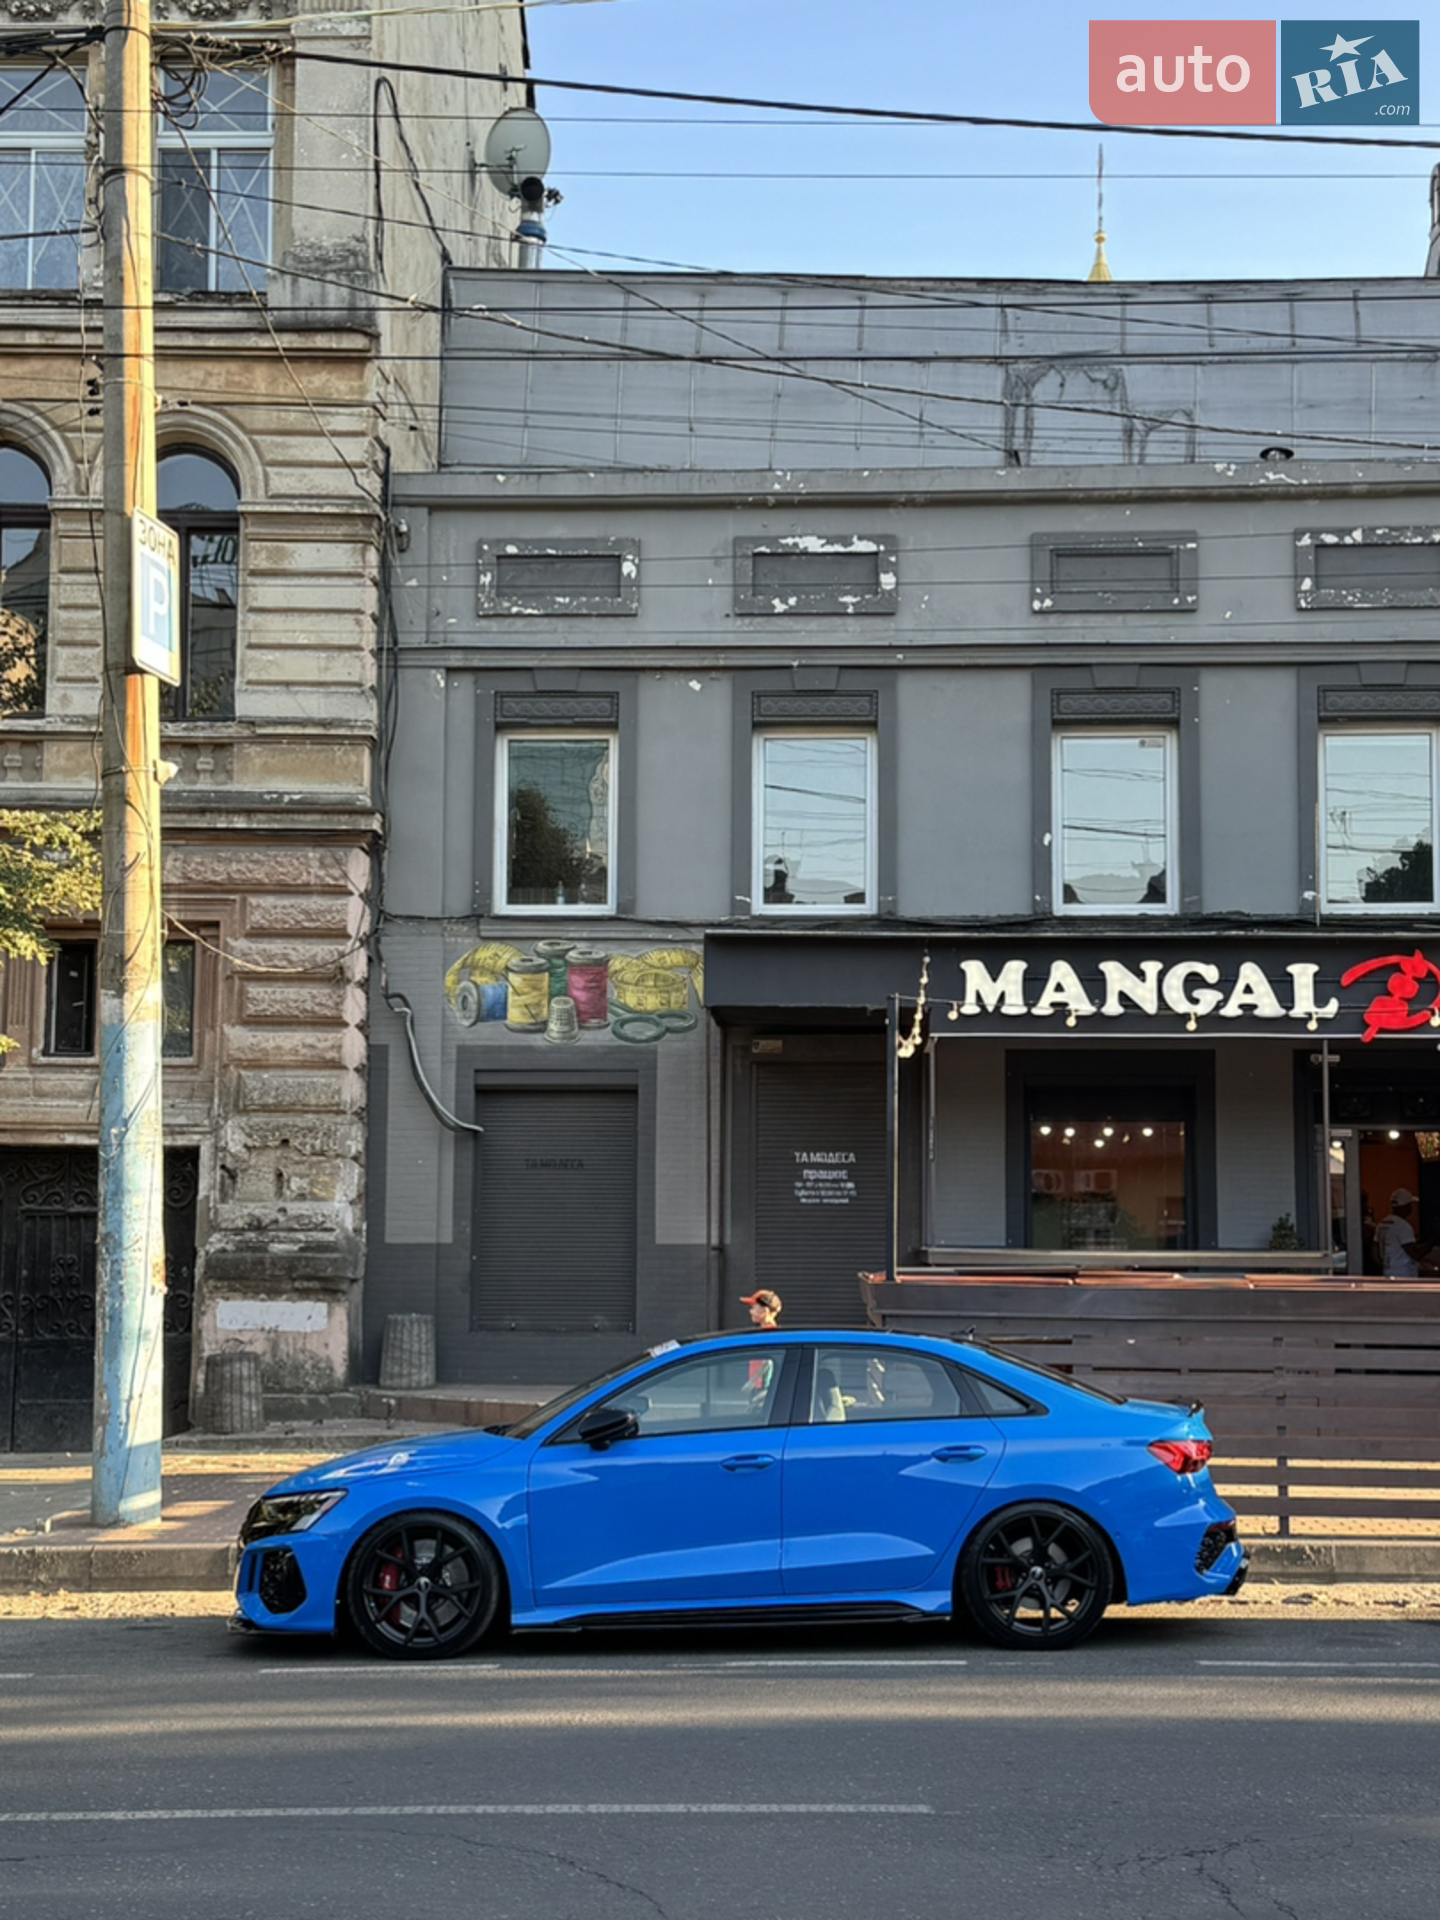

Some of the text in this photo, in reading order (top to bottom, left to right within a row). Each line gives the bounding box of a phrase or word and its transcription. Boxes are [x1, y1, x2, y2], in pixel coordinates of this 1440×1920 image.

[138, 518, 176, 566] ЗОНА
[148, 564, 170, 635] P
[959, 959, 1340, 1018] MANGAL
